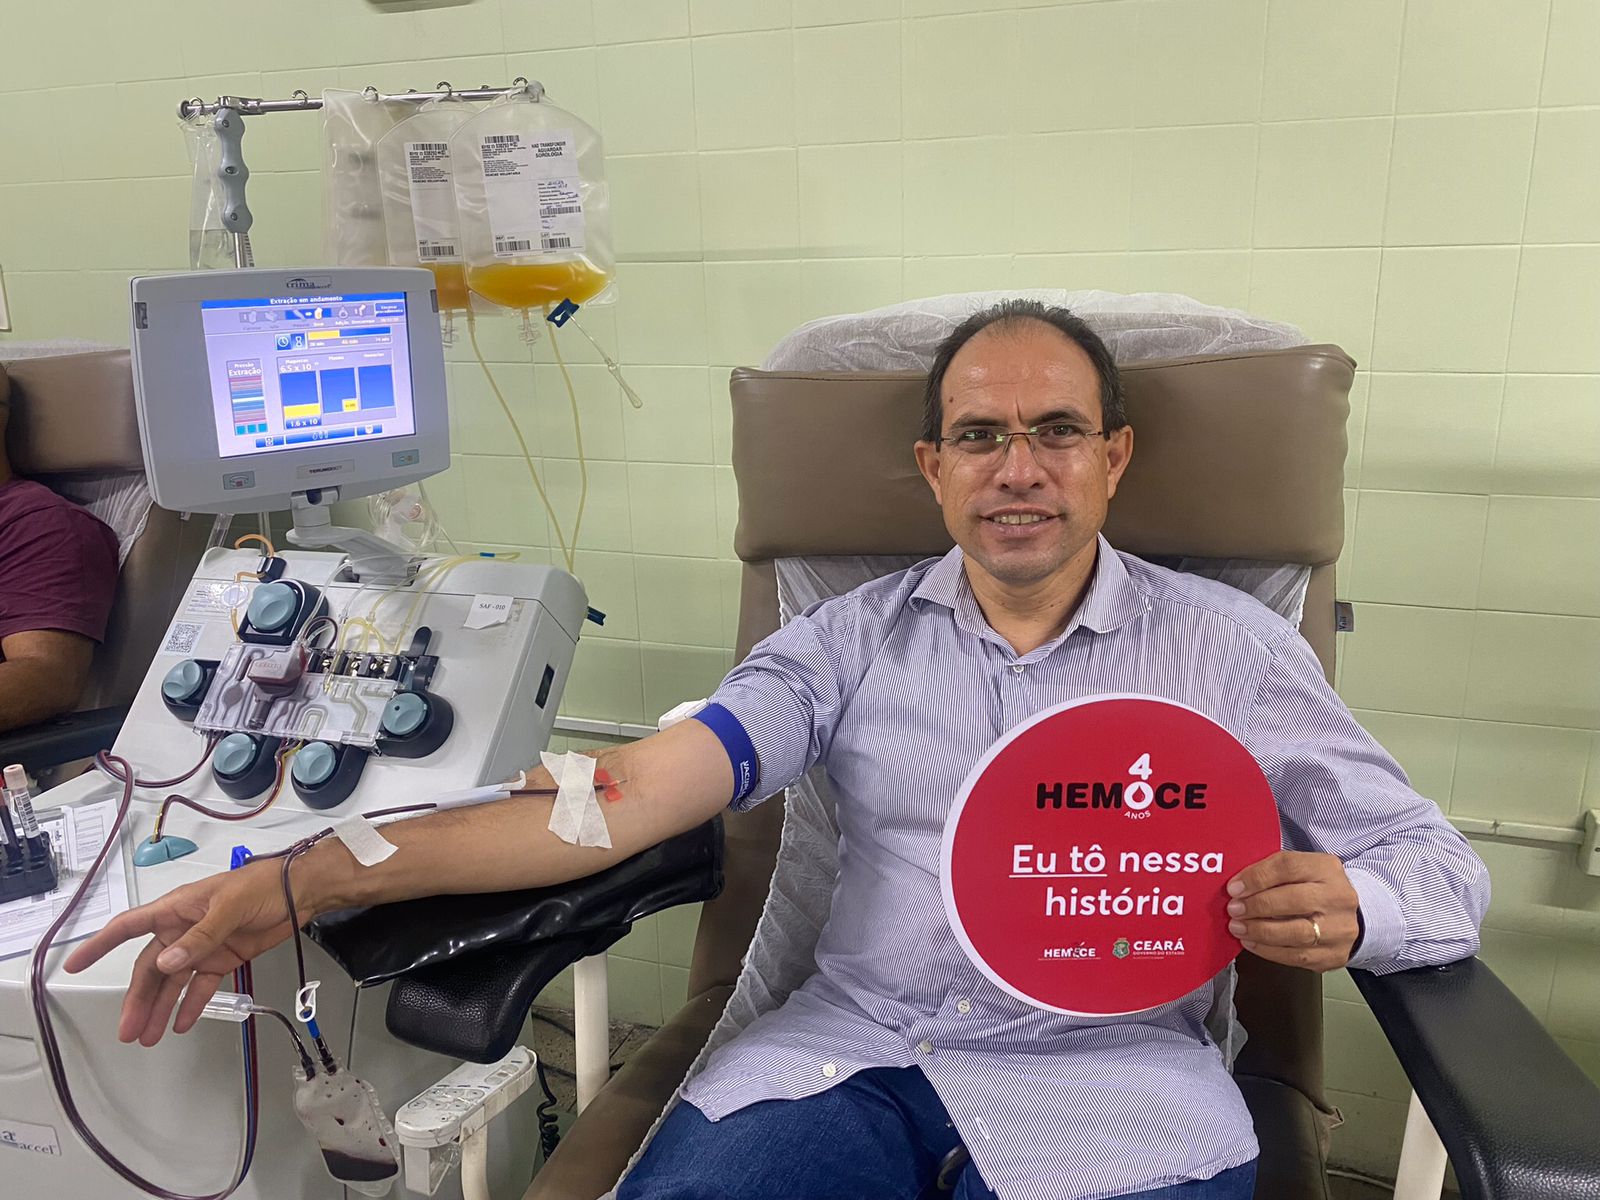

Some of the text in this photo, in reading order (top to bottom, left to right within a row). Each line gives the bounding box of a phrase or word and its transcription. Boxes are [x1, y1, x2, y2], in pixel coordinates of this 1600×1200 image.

[286, 278, 315, 289] trima
[228, 367, 262, 377] Extração
[280, 364, 292, 373] 6.5
[1036, 781, 1208, 810] HEMOCE
[1124, 810, 1152, 820] ANOS
[1012, 844, 1224, 873] Eu tô nessa
[1045, 886, 1185, 916] história
[1133, 937, 1185, 951] CEARÁ
[20, 1143, 54, 1155] accel
